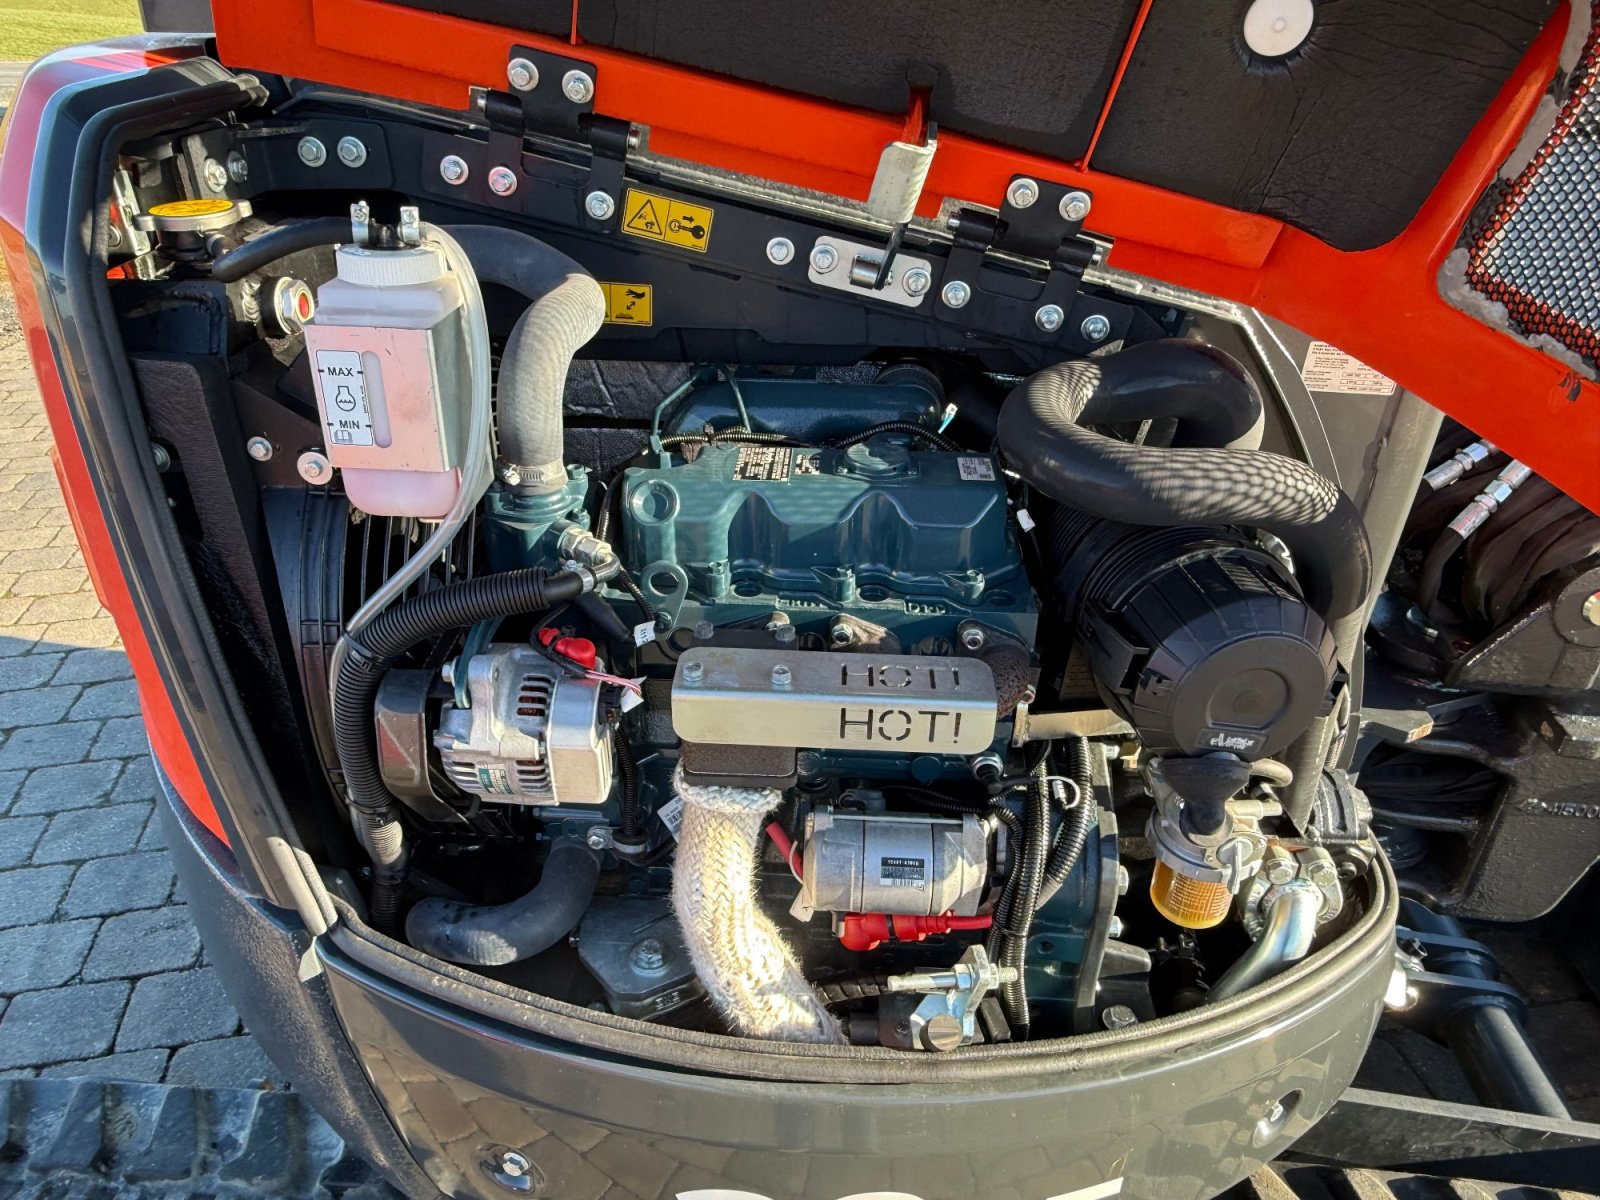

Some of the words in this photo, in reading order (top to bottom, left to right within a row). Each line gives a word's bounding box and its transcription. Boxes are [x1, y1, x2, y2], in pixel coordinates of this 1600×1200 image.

[327, 366, 354, 377] MAX
[339, 419, 360, 430] MIN
[841, 663, 960, 690] HOT!
[840, 707, 962, 744] HOT!
